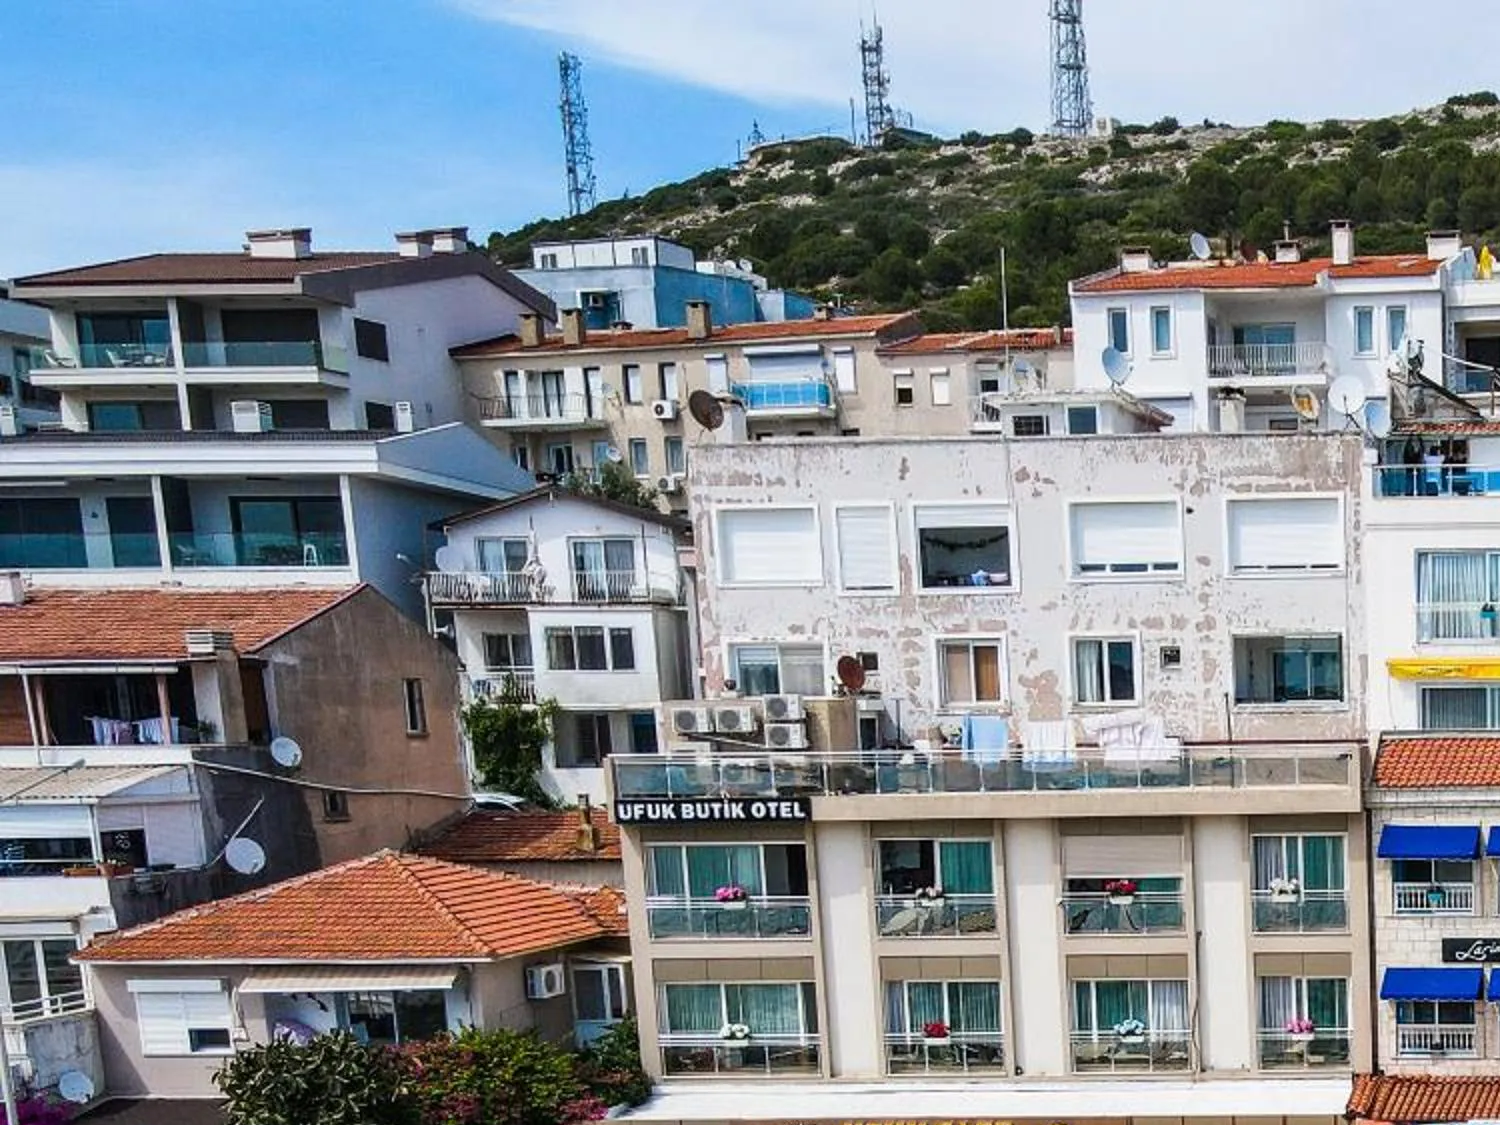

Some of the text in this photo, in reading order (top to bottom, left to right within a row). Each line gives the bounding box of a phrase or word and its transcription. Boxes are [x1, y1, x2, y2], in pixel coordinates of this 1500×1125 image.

[618, 799, 806, 819] UFUK BUTİK OTEL
